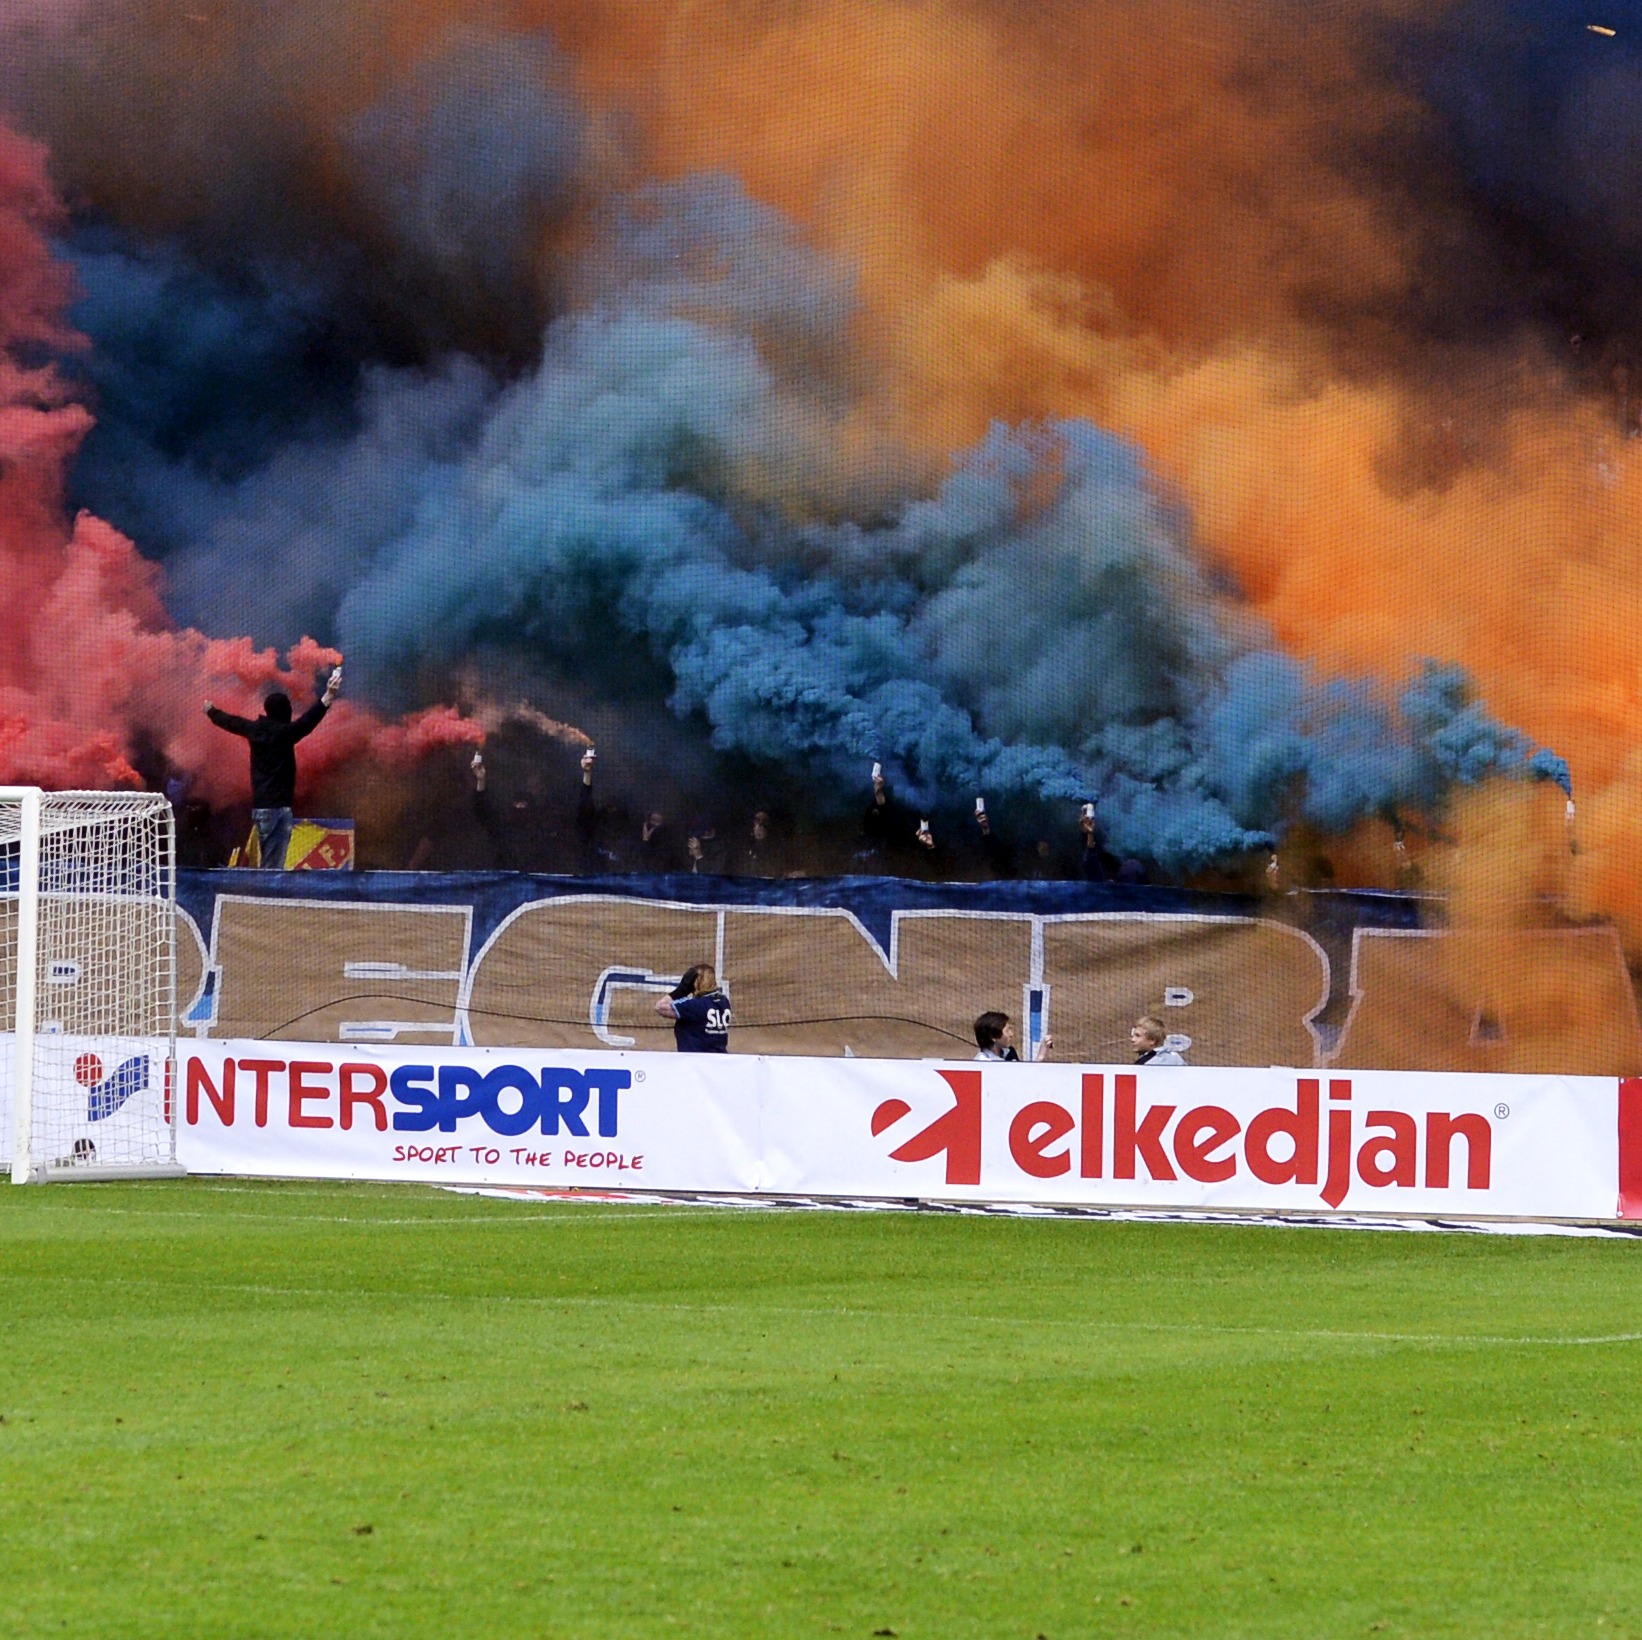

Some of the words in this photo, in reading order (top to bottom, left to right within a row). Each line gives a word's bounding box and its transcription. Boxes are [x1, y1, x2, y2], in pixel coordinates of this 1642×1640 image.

[705, 1008, 732, 1030] SLO
[1008, 1073, 1493, 1210] elkedjan
[392, 1145, 463, 1165] SPORT
[469, 1146, 500, 1165] TO
[509, 1147, 552, 1167] THE
[563, 1150, 645, 1170] PEOPLE
